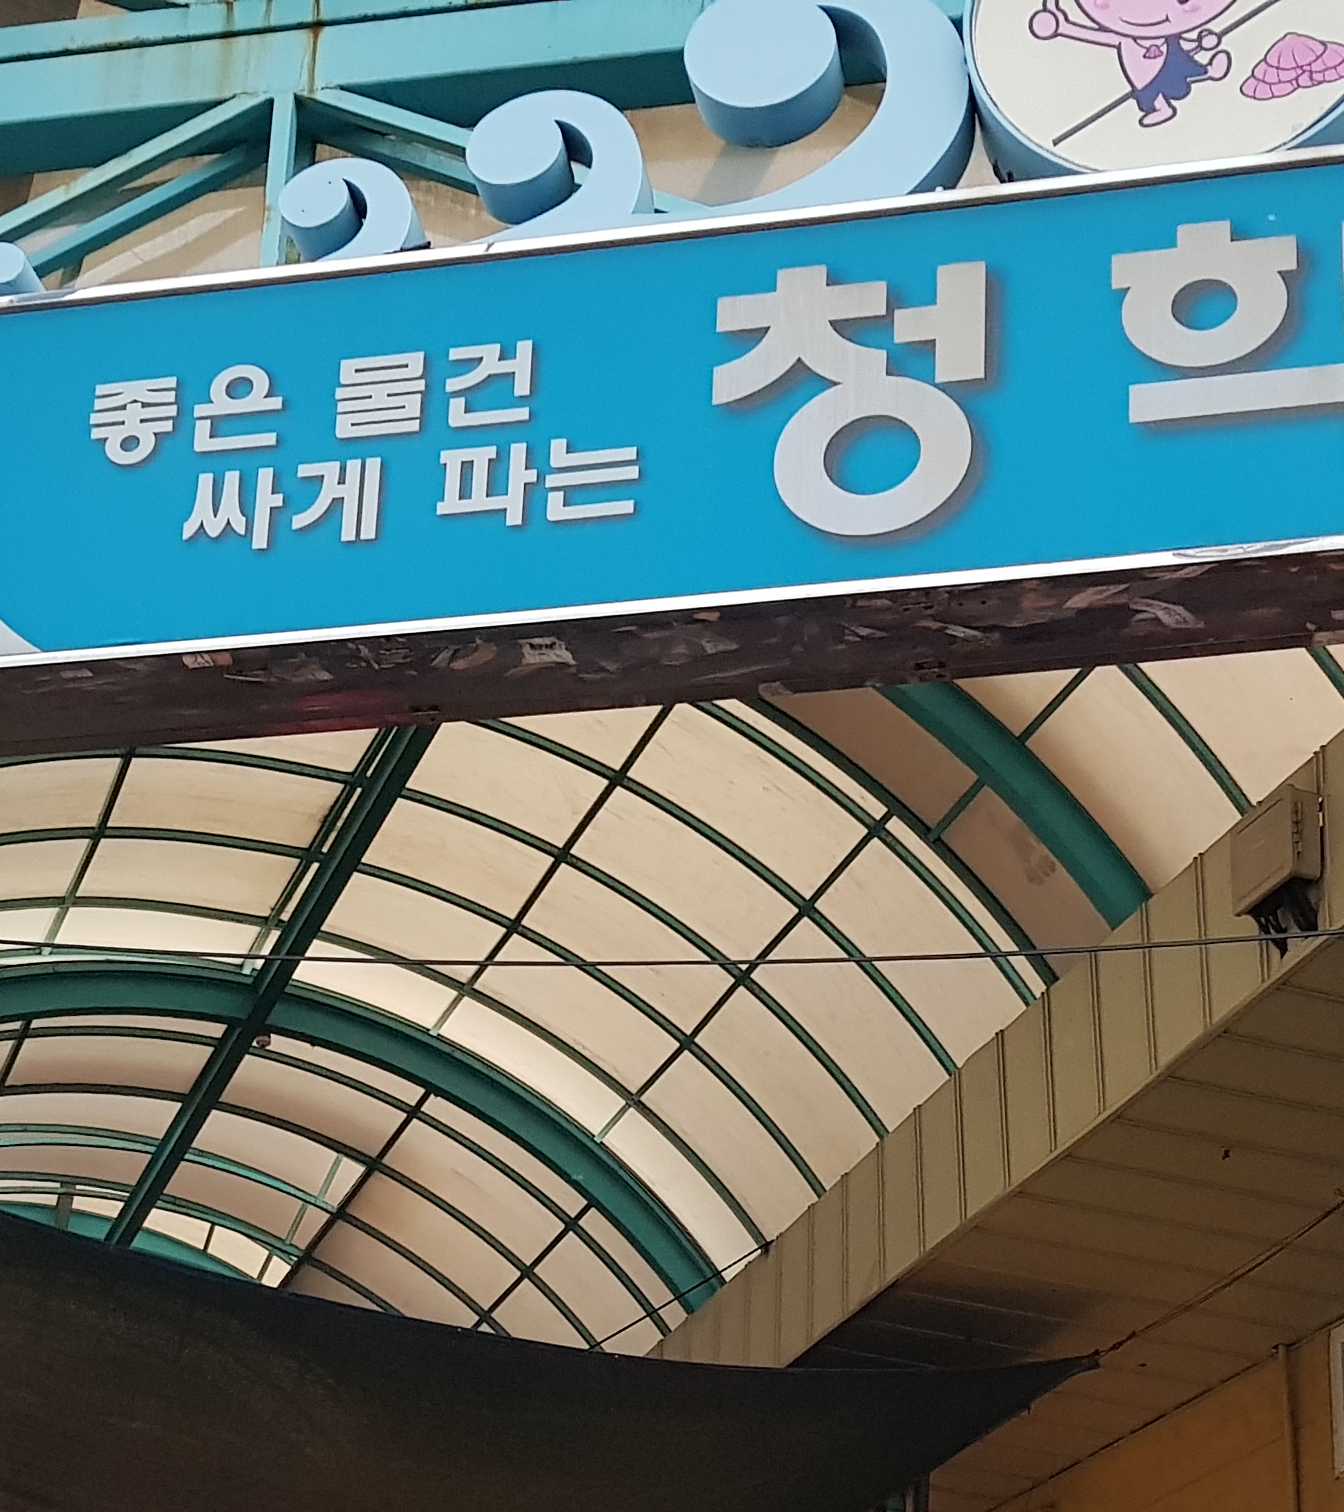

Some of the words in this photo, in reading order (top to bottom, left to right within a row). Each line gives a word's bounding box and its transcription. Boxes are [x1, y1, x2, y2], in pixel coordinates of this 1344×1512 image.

[89, 365, 284, 466] 좋은
[335, 340, 535, 440] 물건
[183, 458, 381, 550] 싸게
[436, 439, 639, 527] 파는
